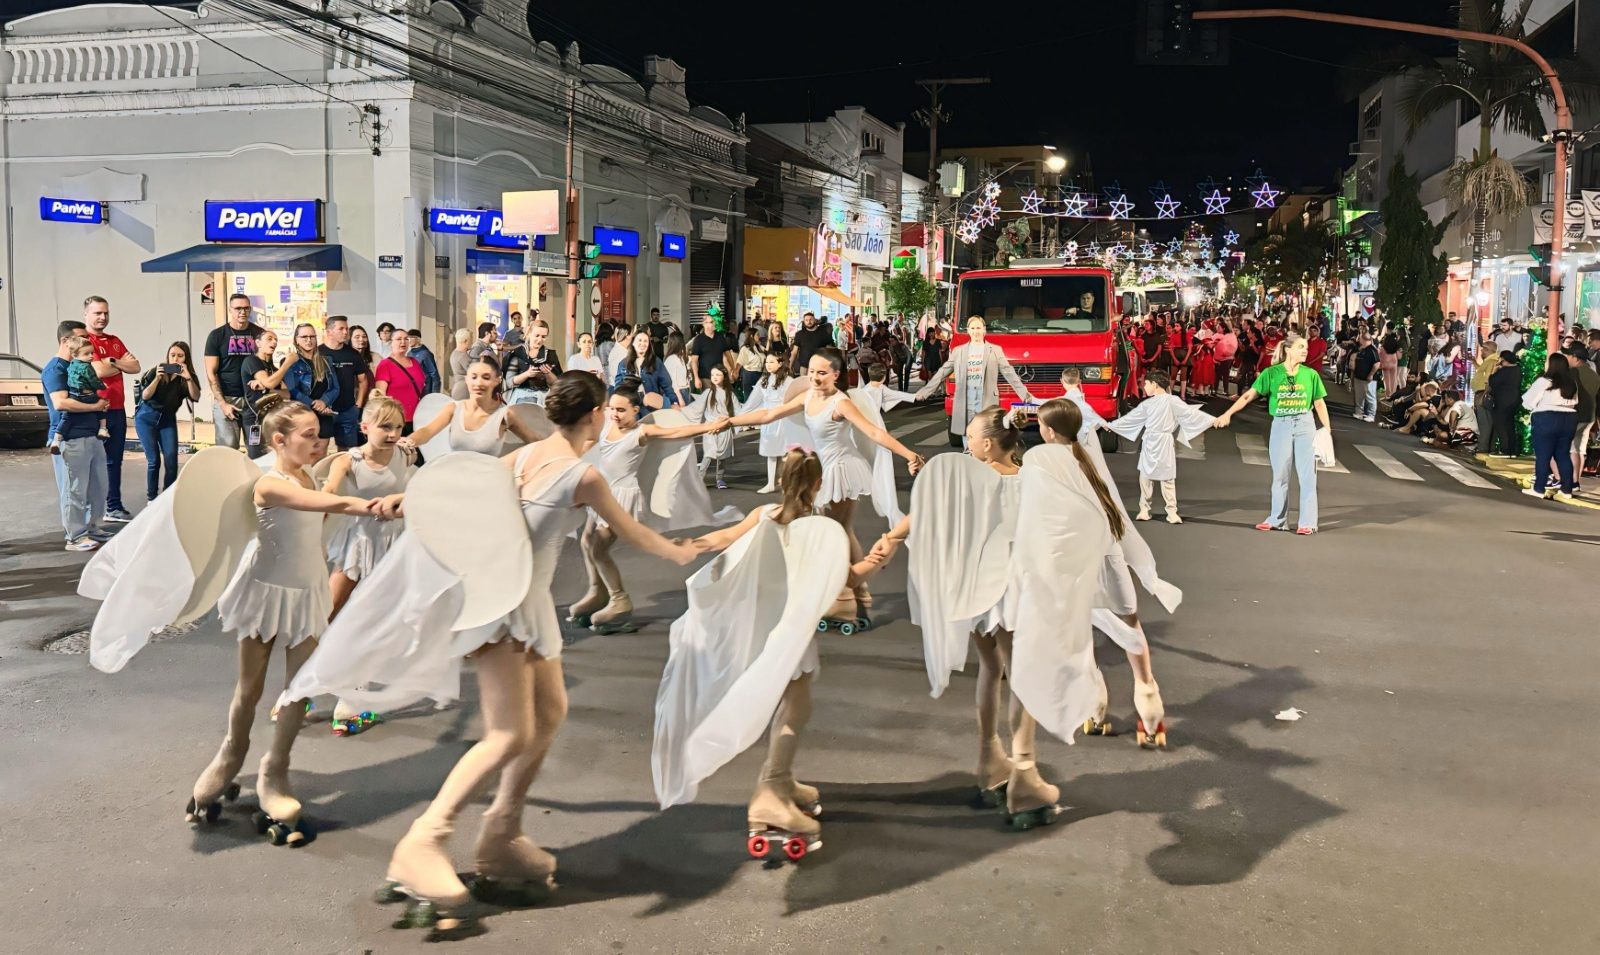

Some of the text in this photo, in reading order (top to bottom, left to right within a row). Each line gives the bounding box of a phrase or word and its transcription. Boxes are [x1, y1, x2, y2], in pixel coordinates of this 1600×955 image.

[52, 201, 95, 216] PanVel
[218, 207, 303, 229] PanVel
[436, 212, 481, 226] PanVel
[265, 228, 297, 236] FARMÁCIAS
[863, 231, 884, 255] João
